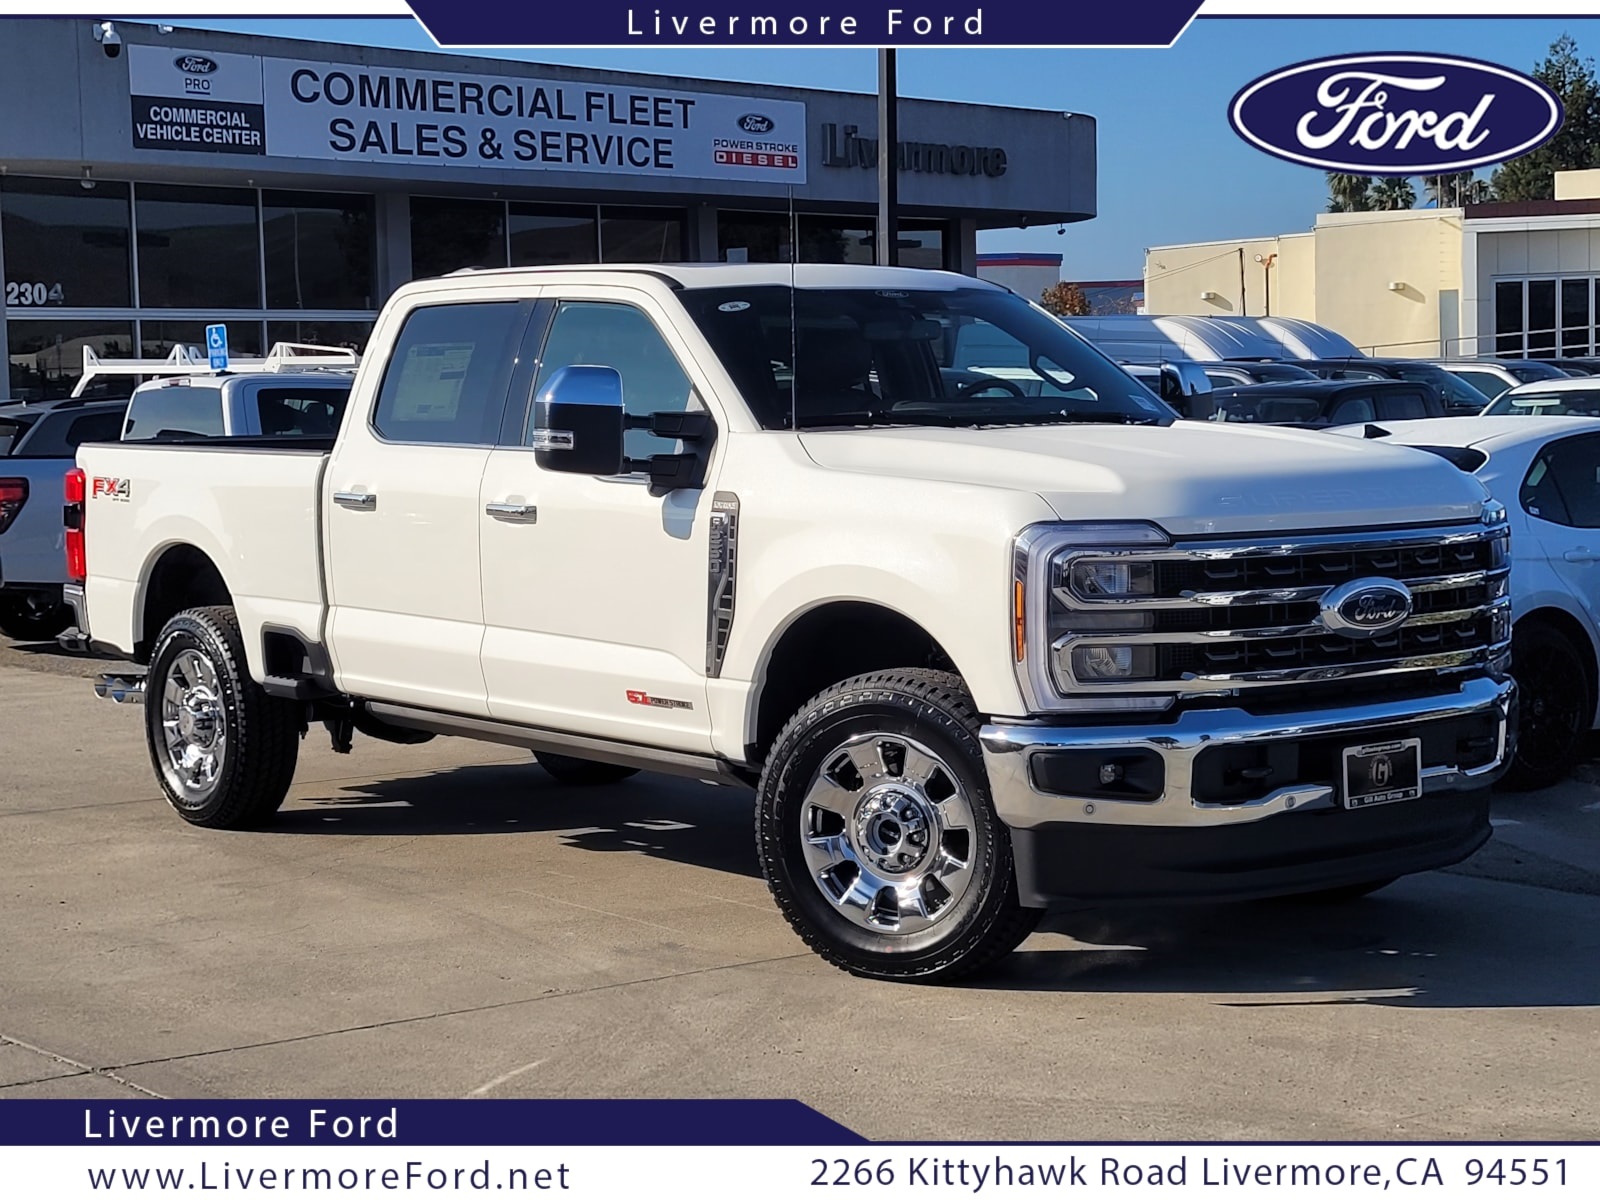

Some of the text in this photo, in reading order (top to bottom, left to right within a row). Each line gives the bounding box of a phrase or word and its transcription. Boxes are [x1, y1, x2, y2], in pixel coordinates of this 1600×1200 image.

[181, 55, 211, 73] Ford
[185, 78, 210, 90] PRO
[291, 69, 695, 129] COMMERCIAL FLEET
[150, 106, 250, 127] COMMERCIAL
[743, 115, 769, 132] Ford
[137, 123, 261, 146] VEHICLE CENTER
[329, 118, 674, 169] SALES & SERVICE
[713, 139, 798, 153] POWER STROKE
[822, 123, 1007, 177] Livrmore
[715, 151, 797, 167] DIESEL
[92, 476, 130, 499] FX4
[1355, 594, 1397, 620] Ford
